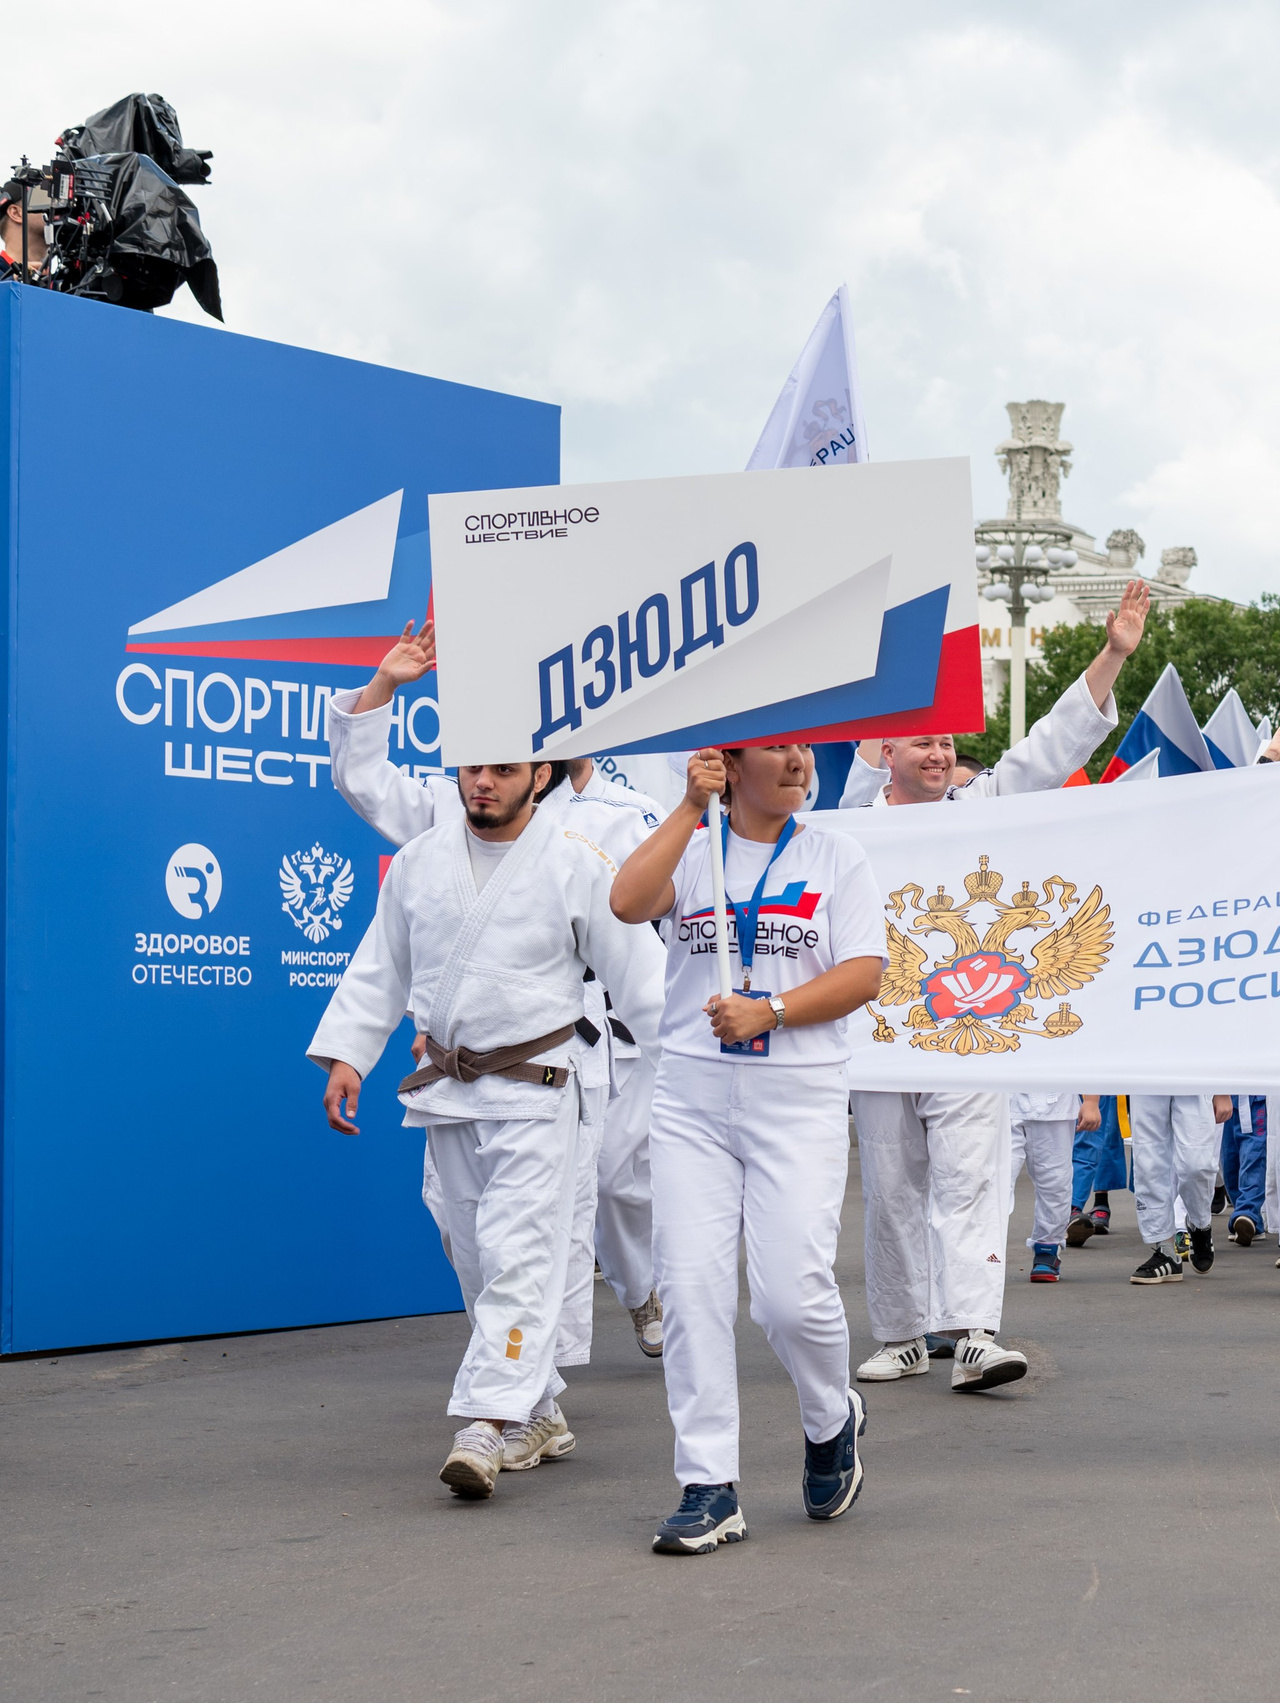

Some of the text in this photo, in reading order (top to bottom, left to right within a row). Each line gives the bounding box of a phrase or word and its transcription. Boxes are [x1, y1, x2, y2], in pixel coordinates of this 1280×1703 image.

[465, 528, 568, 543] ШЕСТВИЕ
[532, 541, 759, 754] ДЗЮДО
[116, 662, 441, 753] СПОРТИНО
[135, 933, 250, 957] ЗДОРОВОЕ
[691, 942, 799, 959] ШЕСВИЕ
[281, 951, 351, 966] МИНСПОРТ
[132, 964, 252, 986] ОТЕЧЕСТВО
[289, 972, 342, 987] РОССИИ
